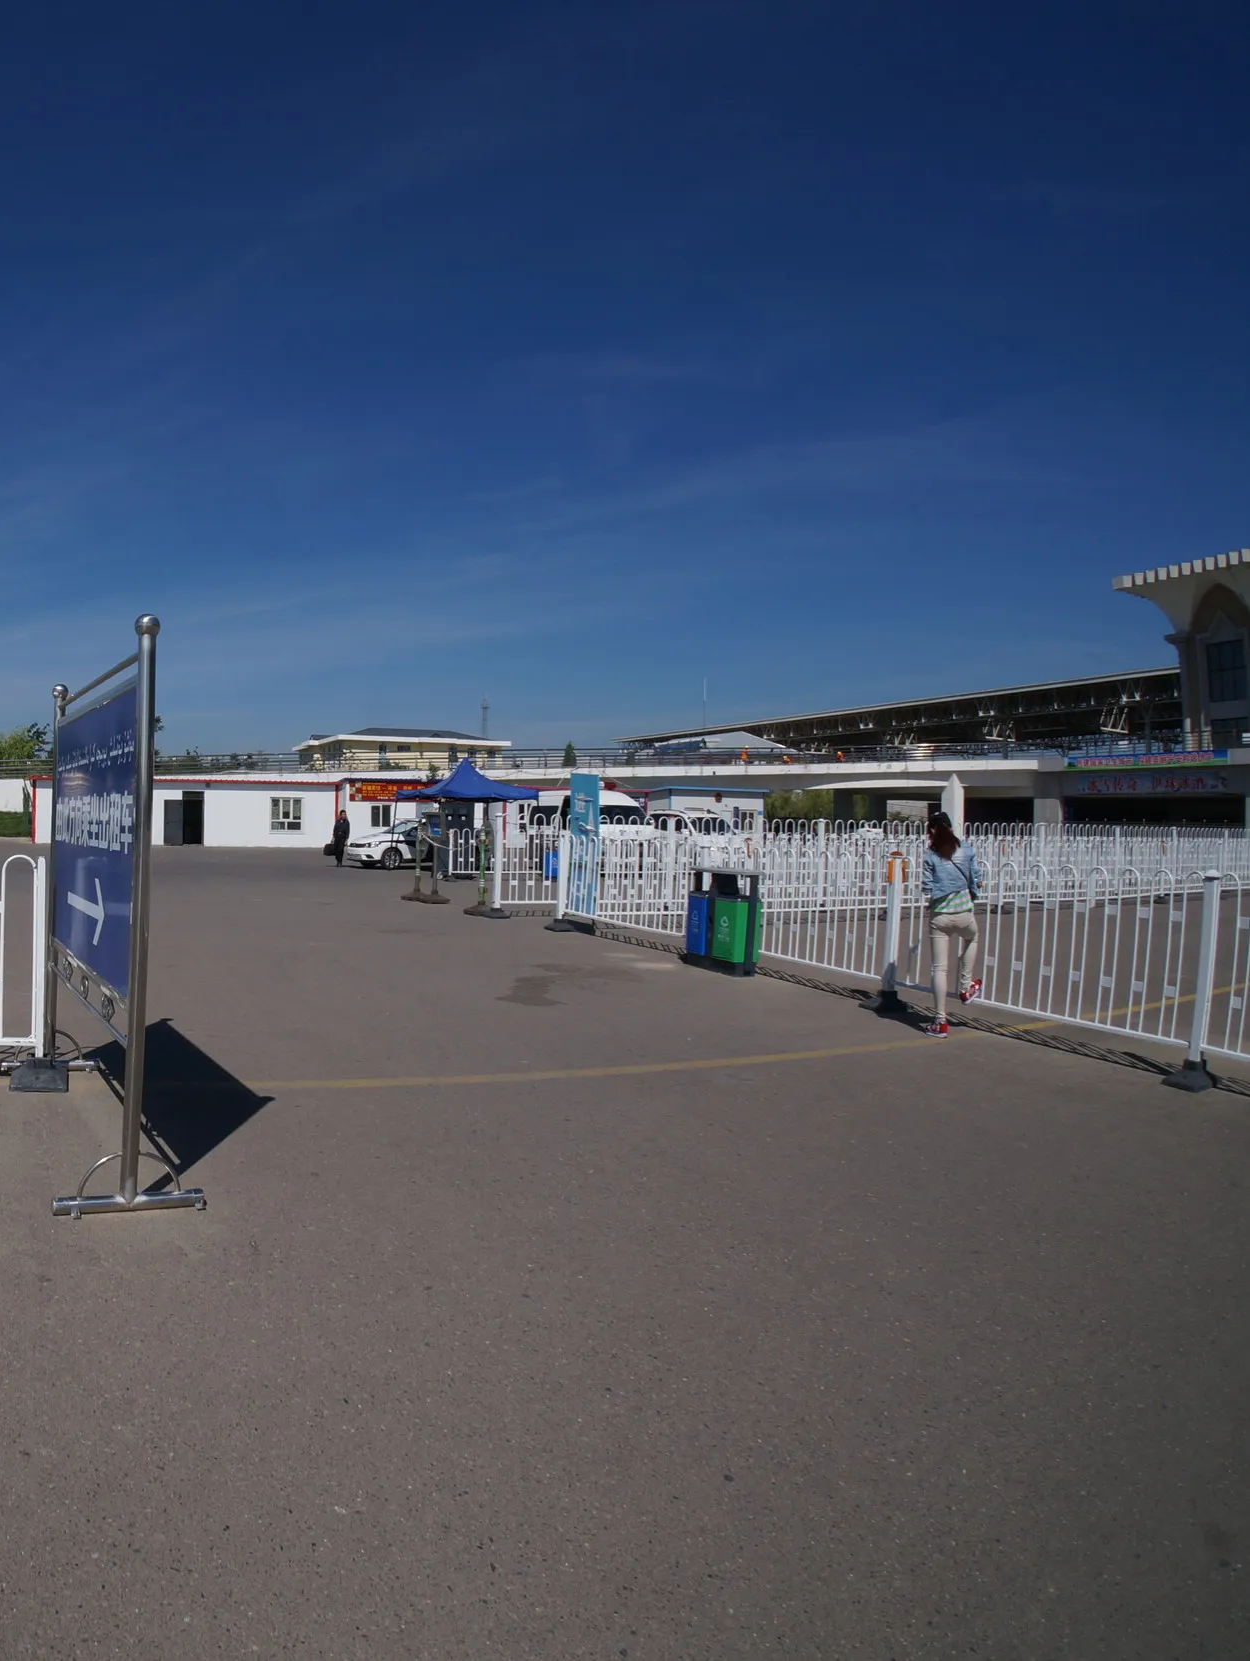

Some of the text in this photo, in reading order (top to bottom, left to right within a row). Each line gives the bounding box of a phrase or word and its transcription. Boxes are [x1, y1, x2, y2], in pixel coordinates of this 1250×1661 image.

[55, 790, 134, 854] 由此方向乘坐出租车
